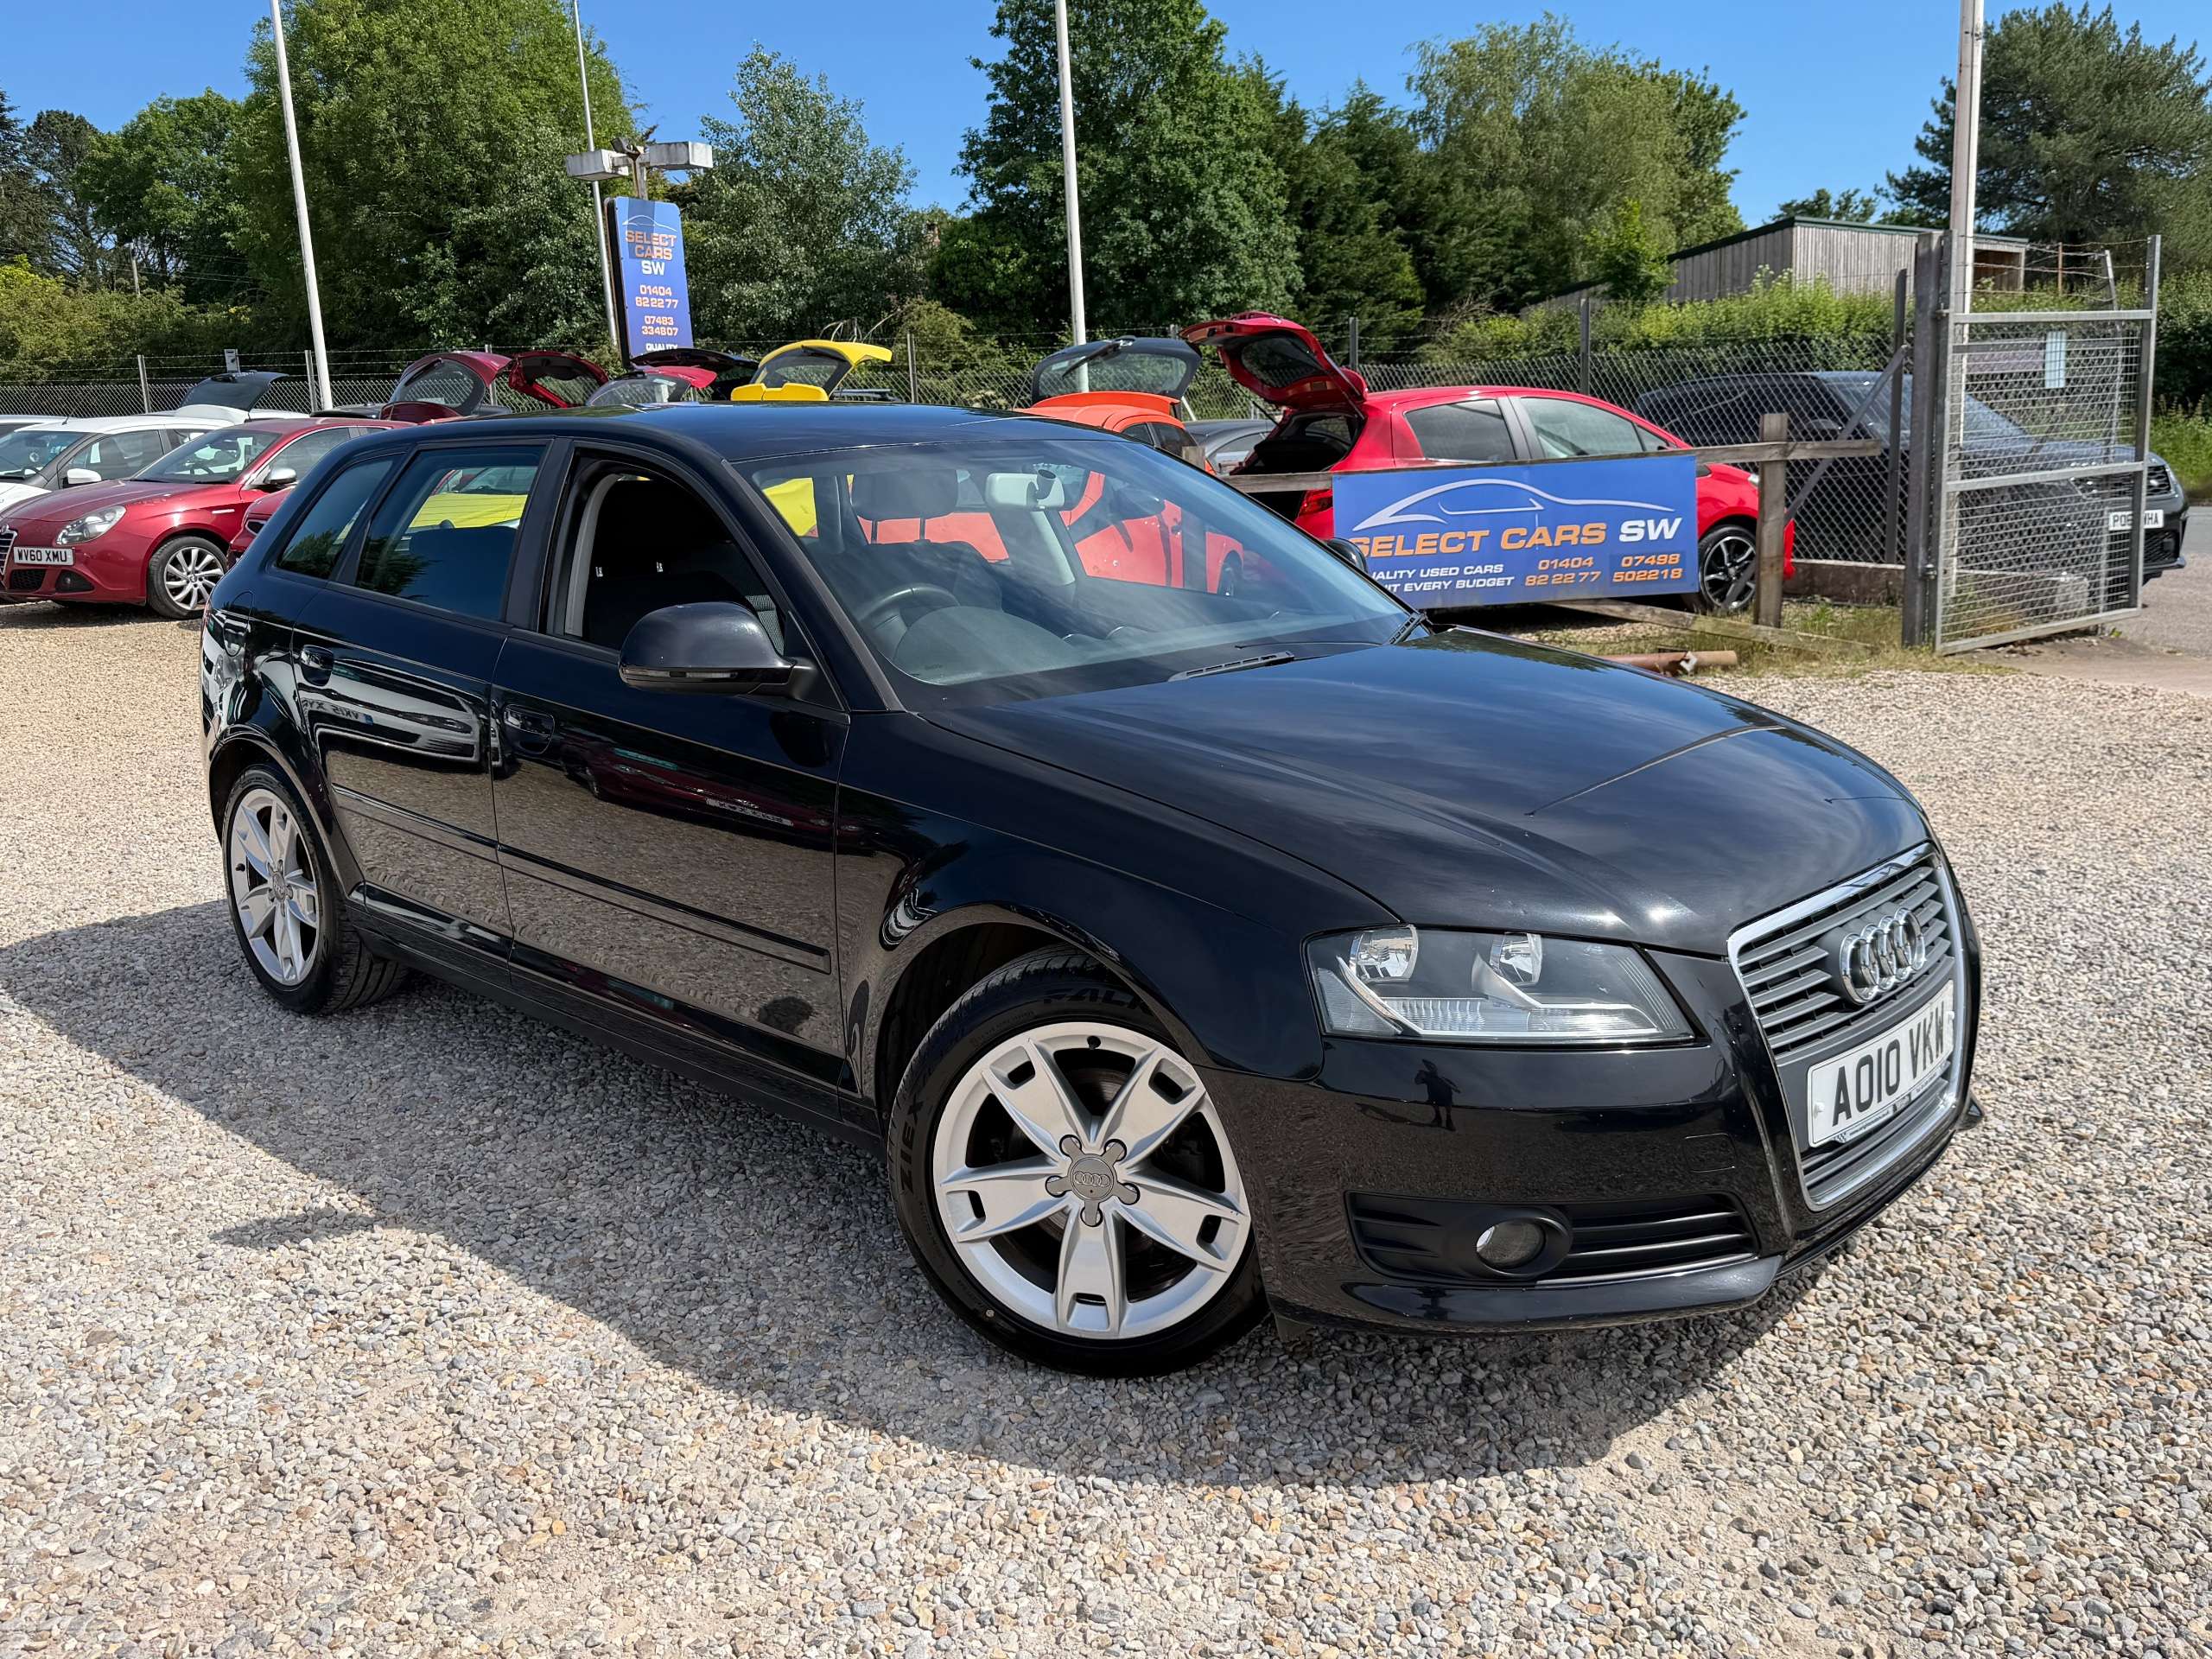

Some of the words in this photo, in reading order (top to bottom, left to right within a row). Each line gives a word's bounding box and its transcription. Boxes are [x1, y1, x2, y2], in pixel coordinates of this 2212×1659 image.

[625, 230, 677, 248] SELECT
[635, 245, 672, 261] CARS
[641, 260, 665, 276] SW
[639, 284, 672, 296] 01404
[1500, 522, 1607, 550] CARS
[1618, 518, 1682, 543] SW
[17, 549, 42, 562] WV60
[45, 550, 67, 563] XMU
[1538, 556, 1593, 570] 01404
[1621, 553, 1681, 568] 07498
[1371, 569, 1417, 582] ALITY
[1420, 566, 1459, 578] USED
[1463, 563, 1504, 575] CARS
[1612, 568, 1683, 582] 502218
[1403, 580, 1452, 592] EVERY
[1455, 576, 1515, 589] BUDGET
[1832, 1039, 1901, 1127] AO10
[1909, 1000, 1945, 1080] VKW
